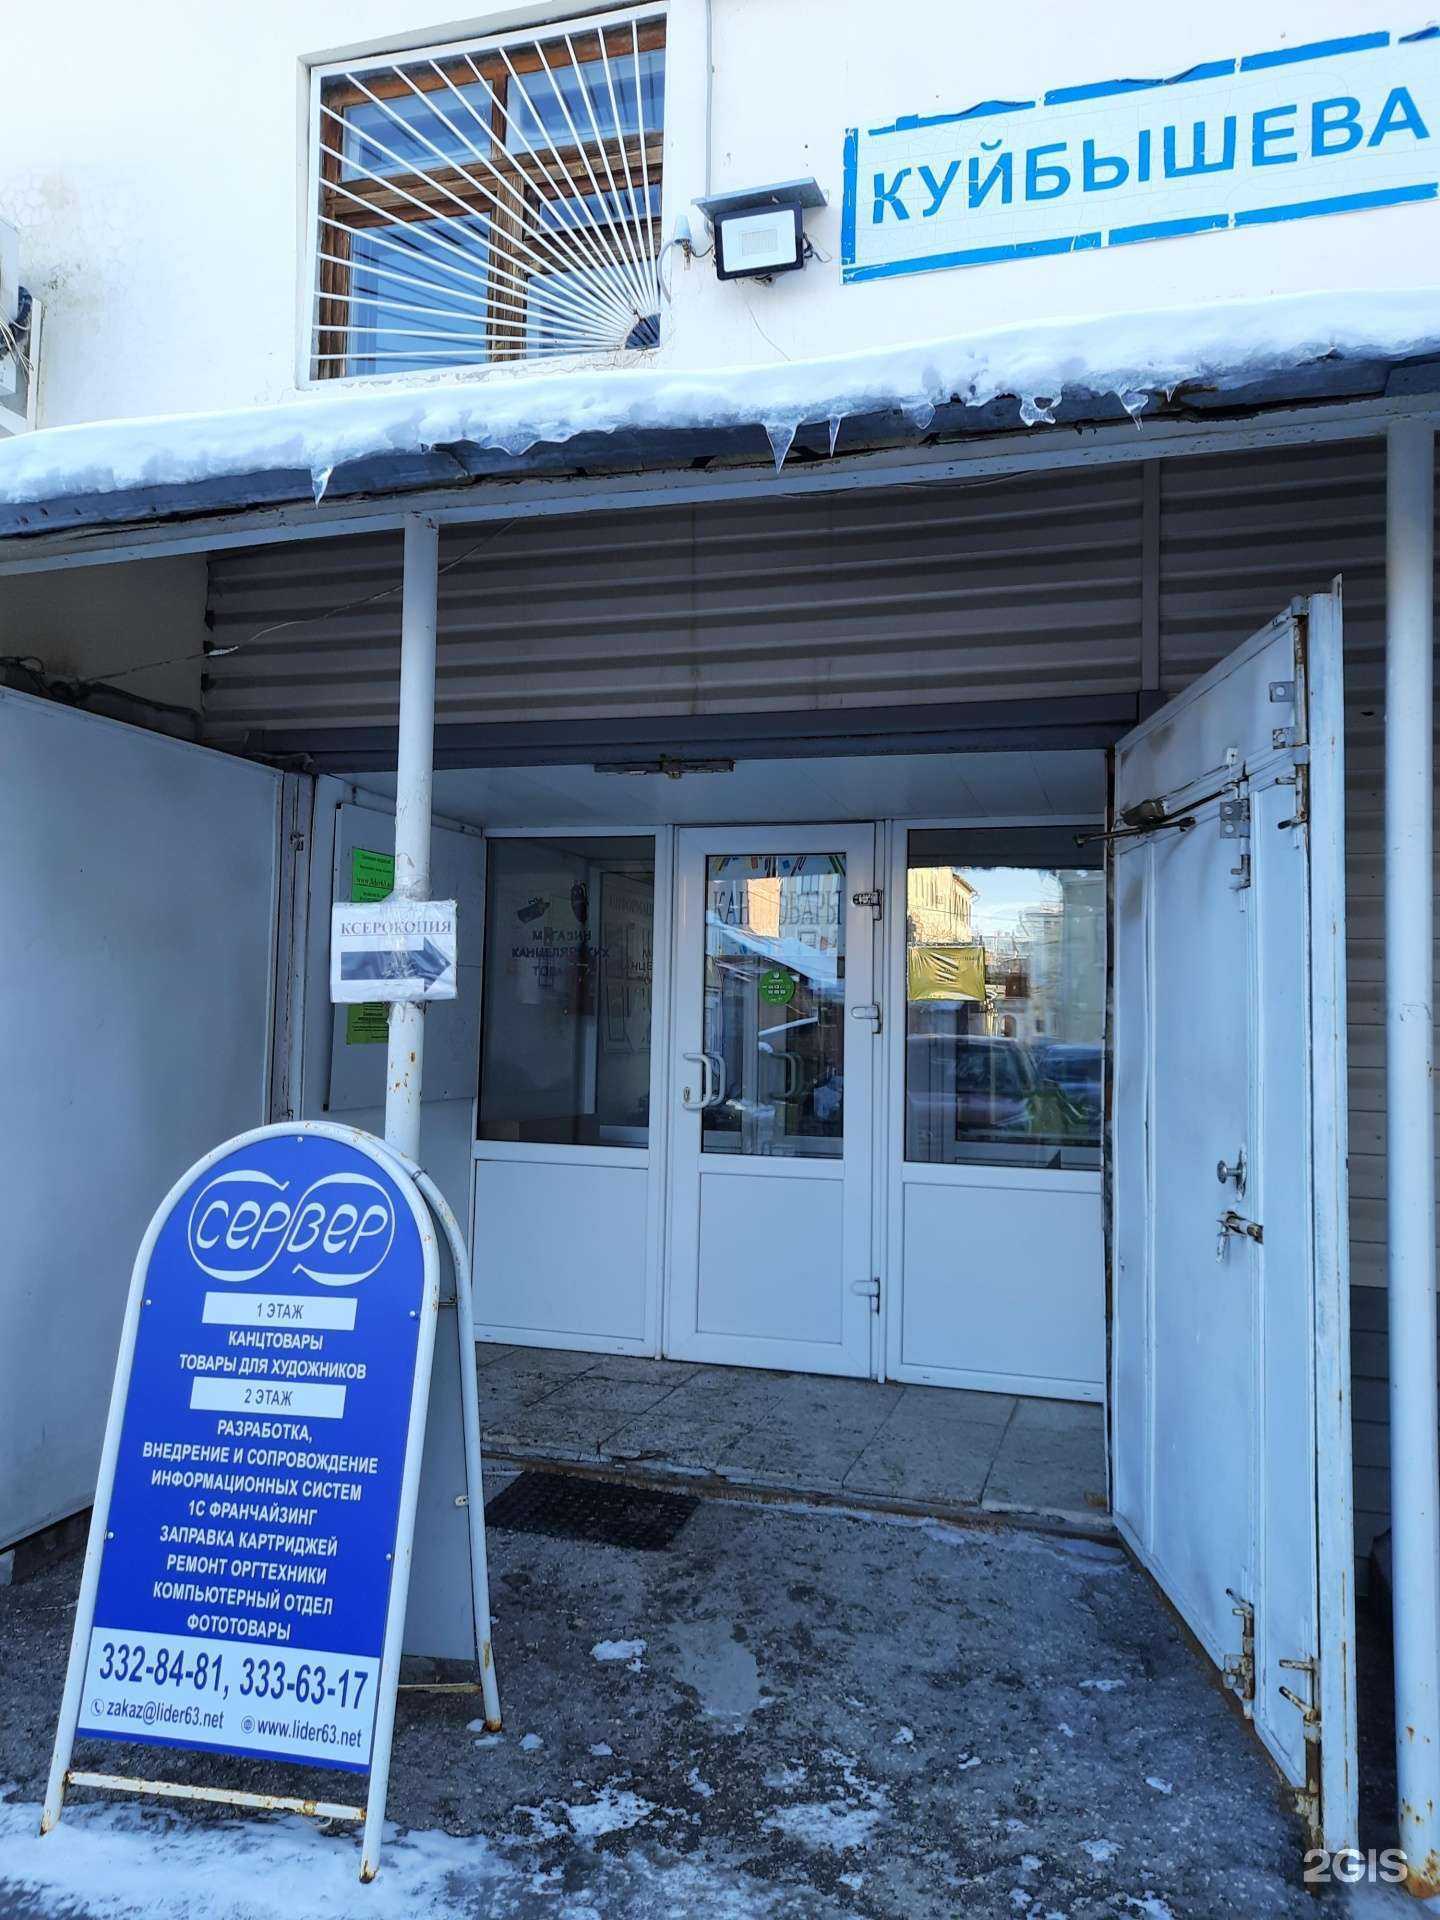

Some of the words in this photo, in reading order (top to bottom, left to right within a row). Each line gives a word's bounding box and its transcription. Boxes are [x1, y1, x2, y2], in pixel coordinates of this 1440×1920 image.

[872, 86, 1430, 224] КУЙБЫШЕВА
[341, 920, 452, 935] КСЕРОКОПИЯ
[256, 1303, 263, 1318] 1
[266, 1303, 304, 1319] ЭТАЖ
[228, 1330, 324, 1350] КАНЦТОВАРЫ
[179, 1353, 237, 1372] ТОВАРЫ
[238, 1357, 268, 1375] ДЛЯ
[271, 1358, 367, 1380] ХУДОЖНИКОВ
[244, 1388, 251, 1404] 2
[255, 1389, 294, 1406] ЭТАЖ
[217, 1419, 313, 1443] РАЗРАБОТКА,
[142, 1441, 229, 1463] ВНЕДРЕНИЕ
[233, 1447, 244, 1463] И
[247, 1449, 379, 1474] СОПРОВОЖДЕНИЕ
[151, 1469, 298, 1496] ИНФОРМАЦИОННЫХ
[302, 1481, 362, 1501] СИСТЕМ
[188, 1500, 206, 1517] 1С
[209, 1502, 318, 1526] ФРАНЧАЙЗИНГ
[159, 1525, 235, 1547] ЗАПРАВКА
[238, 1532, 338, 1557] КАРТРИДЖЕЙ
[166, 1553, 228, 1575] РЕМОНТ
[231, 1560, 328, 1585] ОРГТЕХНИКИ
[153, 1581, 281, 1610] КОМПЬЮТЕРНЫЙ
[284, 1594, 334, 1616] ОТДЕЛ
[186, 1613, 291, 1641] ФОТОТОВАРЫ
[99, 1642, 229, 1701] 332-84-81,
[240, 1657, 369, 1709] 333-63-17
[106, 1699, 225, 1729] zakaz@lider63.net
[257, 1717, 363, 1748] www.lider63.net
